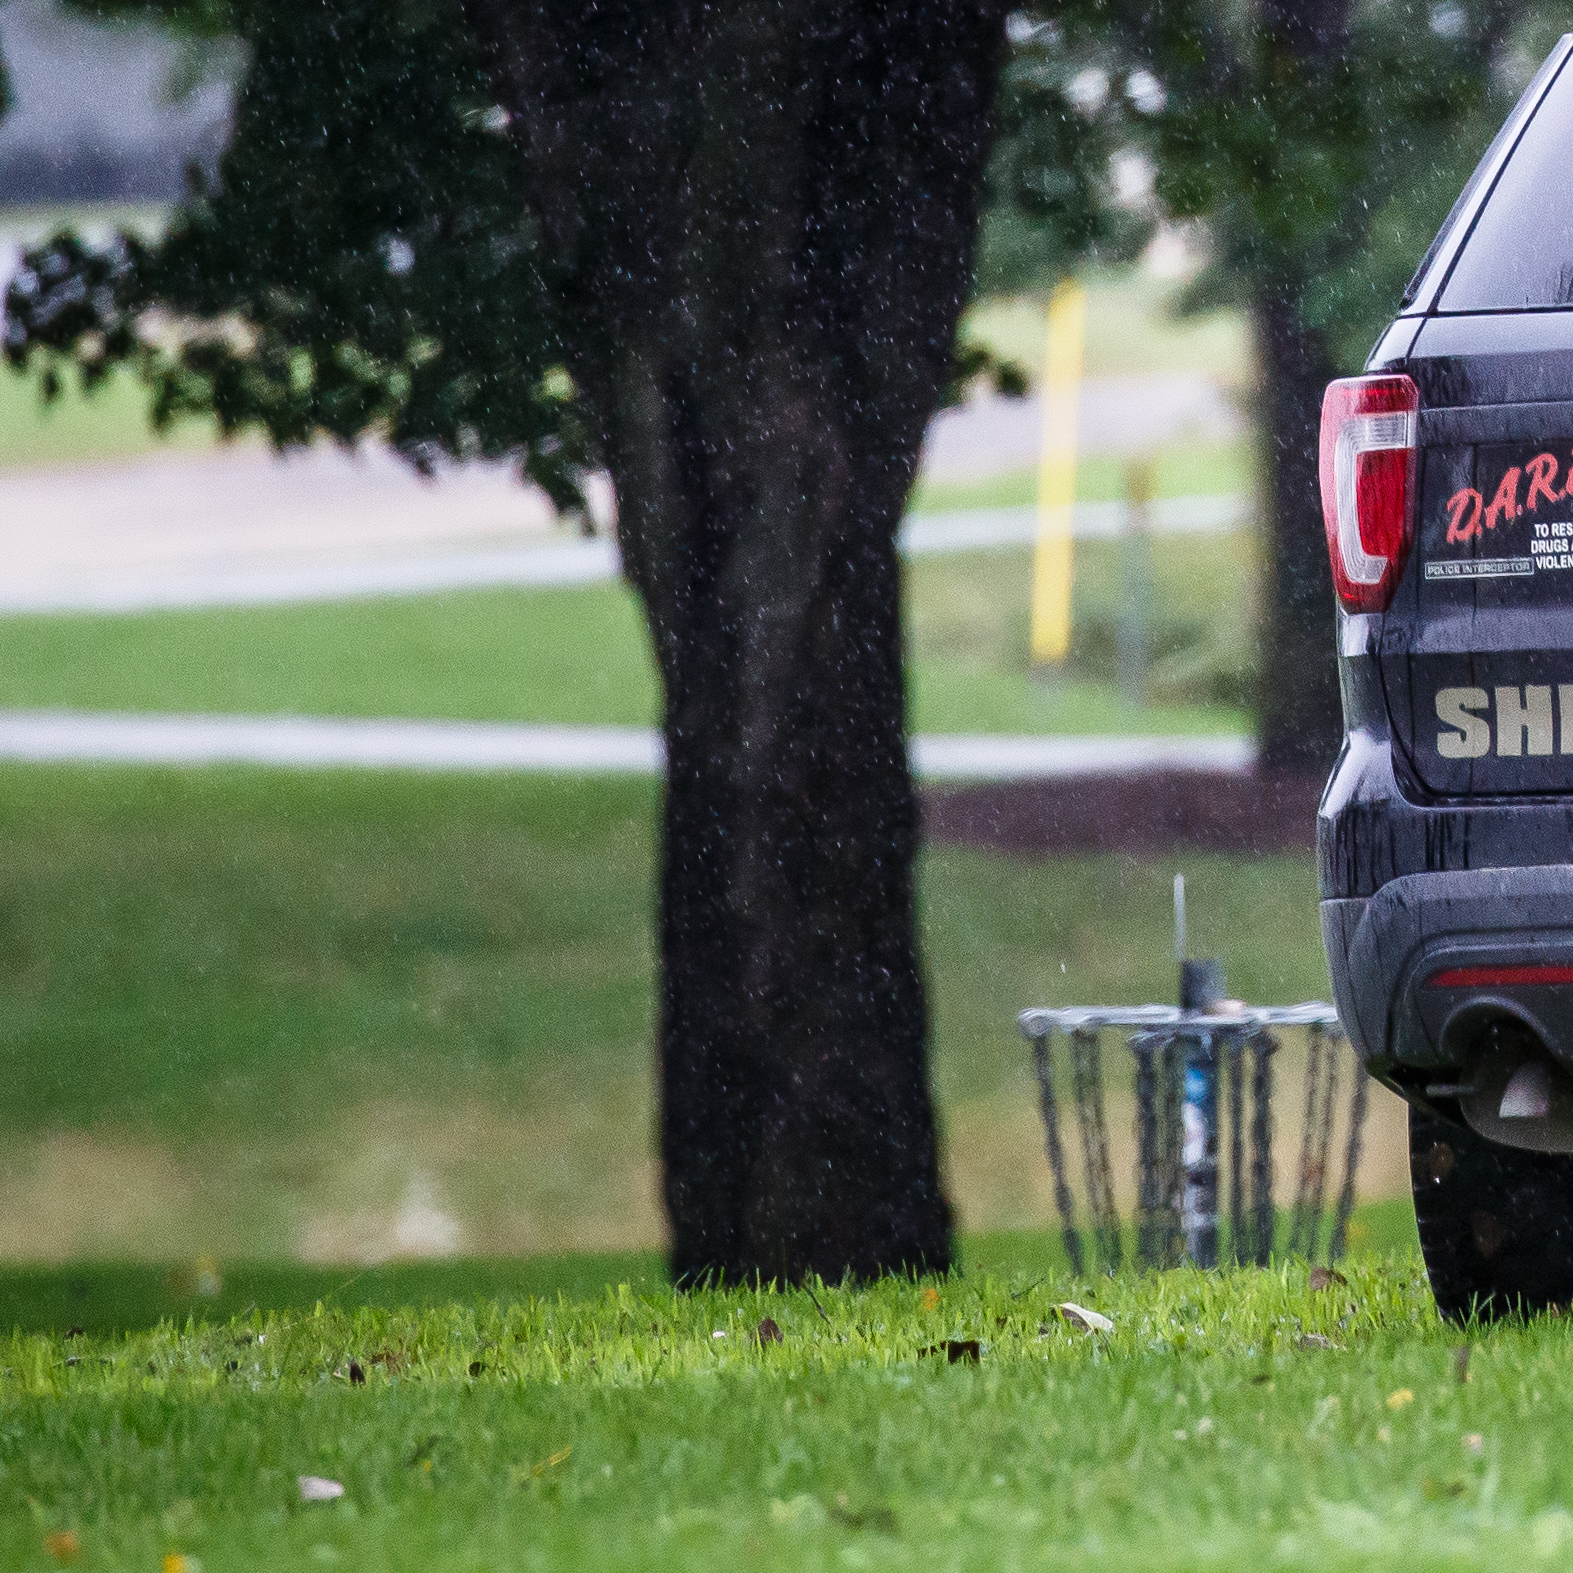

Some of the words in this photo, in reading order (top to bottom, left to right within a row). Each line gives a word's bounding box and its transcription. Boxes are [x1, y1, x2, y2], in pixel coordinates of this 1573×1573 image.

[1534, 523, 1549, 538] TO
[1530, 539, 1569, 554] DRUGS
[1427, 564, 1460, 576] POLICE
